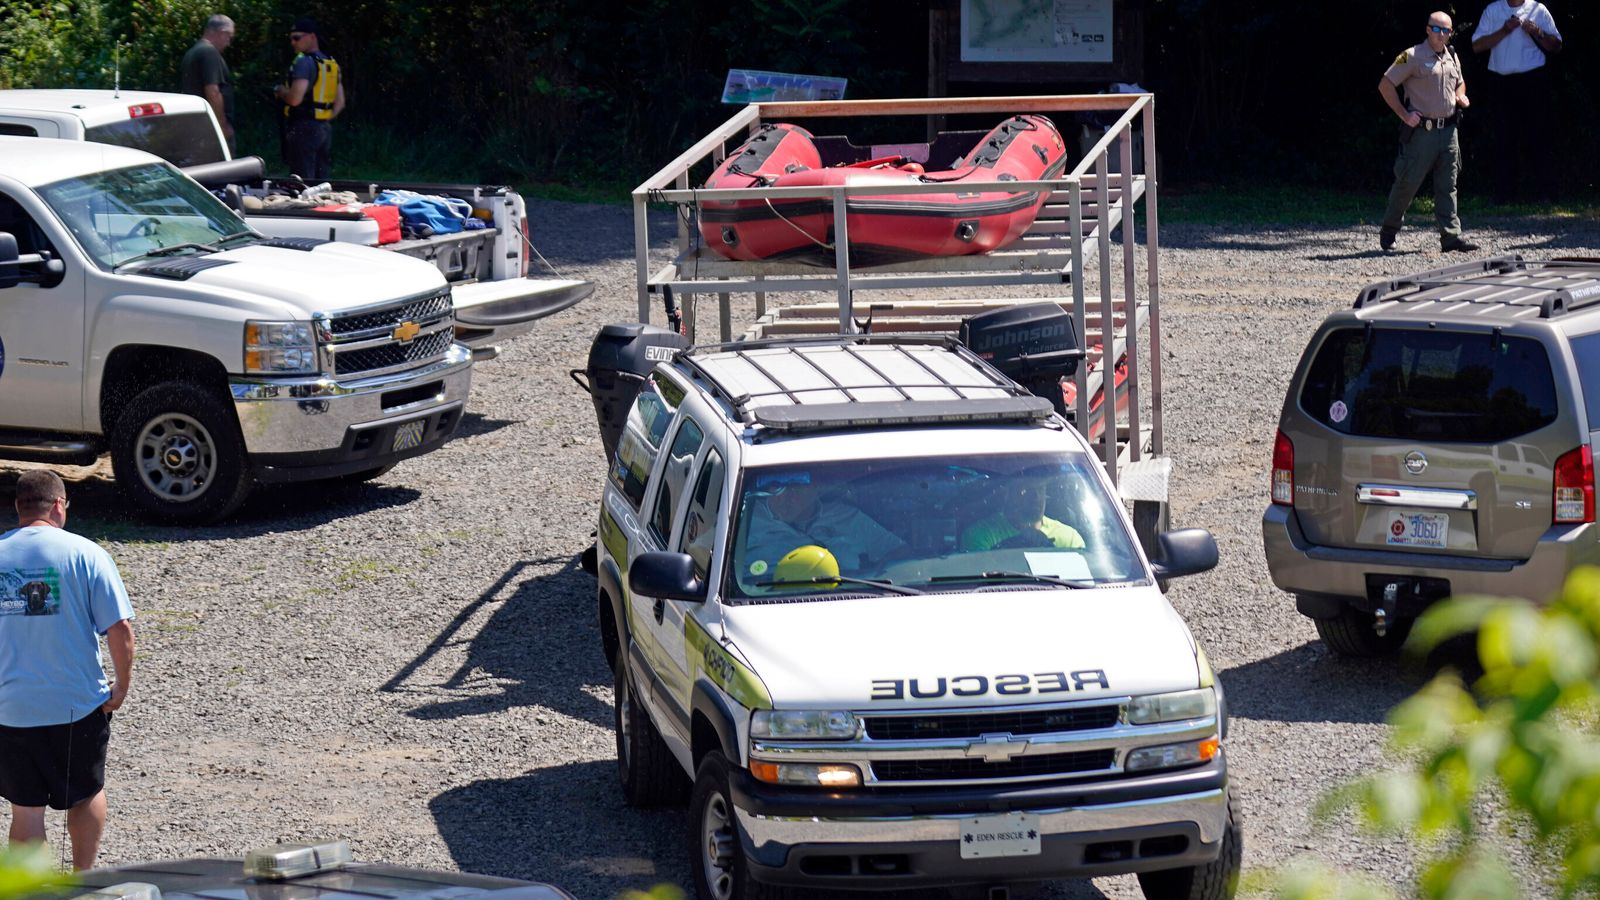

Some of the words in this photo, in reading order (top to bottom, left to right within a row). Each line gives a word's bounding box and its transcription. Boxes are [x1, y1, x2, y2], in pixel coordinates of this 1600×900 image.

[979, 322, 1065, 350] Johnson
[976, 832, 996, 842] EDEN
[997, 831, 1025, 841] RESCUE
